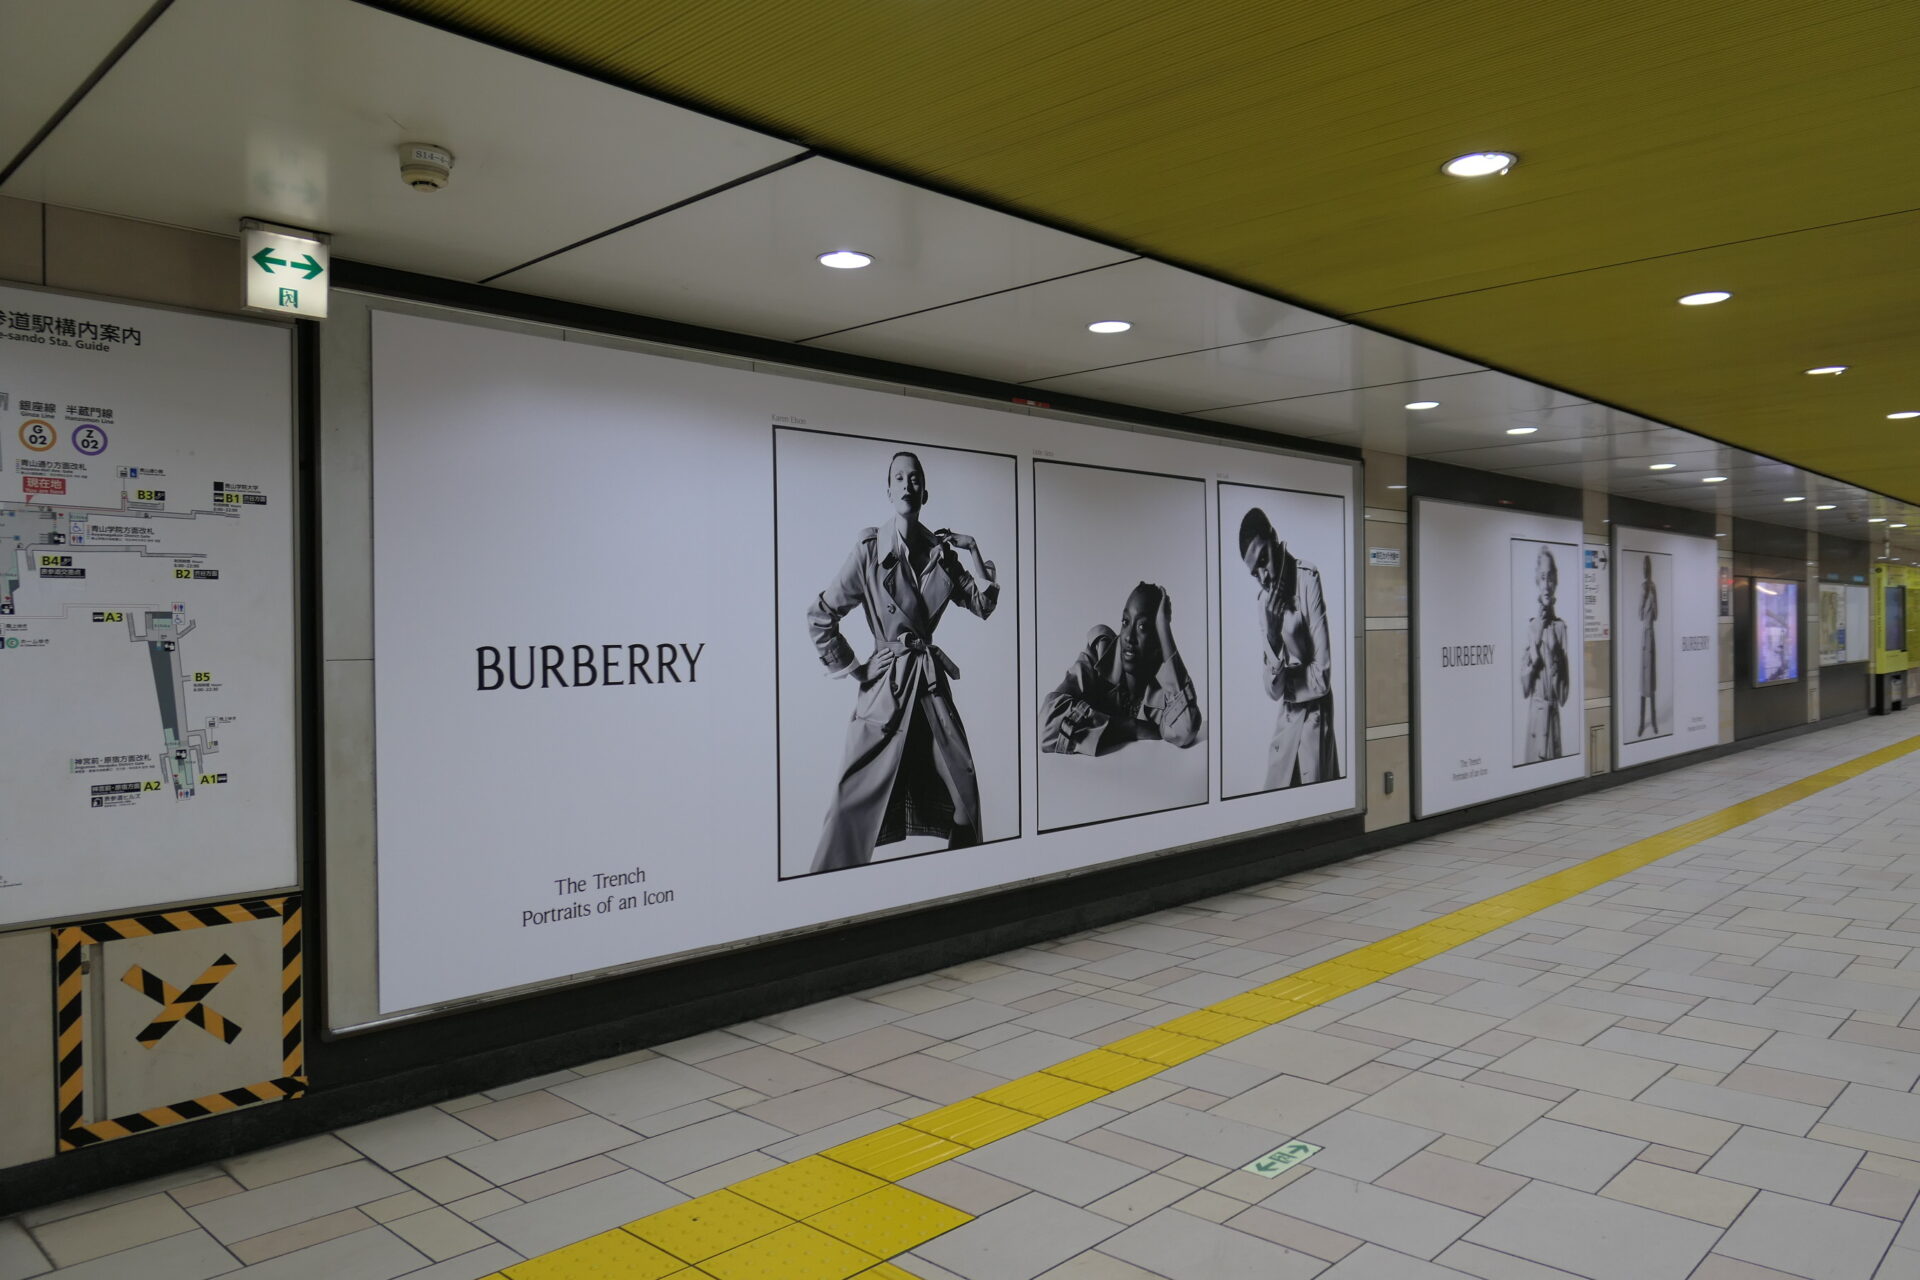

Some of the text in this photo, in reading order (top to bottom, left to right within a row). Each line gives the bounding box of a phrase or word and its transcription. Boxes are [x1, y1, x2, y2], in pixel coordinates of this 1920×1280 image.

[50, 336, 72, 348] Sta.
[75, 340, 110, 353] Guide
[19, 400, 56, 413] 銀座線
[66, 405, 113, 419] 半蔵門線
[33, 424, 43, 434] G
[86, 430, 95, 439] Z
[29, 434, 47, 445] 02
[81, 439, 99, 450] 02
[27, 478, 62, 489] 現在地
[138, 490, 154, 500] B3
[226, 494, 240, 503] B1
[42, 556, 59, 566] B4
[176, 569, 191, 579] B2
[105, 612, 123, 622] A3
[1442, 644, 1495, 668] BURBERRY
[476, 643, 706, 691] BURBERRY
[195, 672, 210, 682] B5
[201, 774, 216, 785] A1
[143, 781, 162, 791] A2
[554, 866, 646, 896] The Trench
[522, 888, 675, 928] Portraits of an Icon
